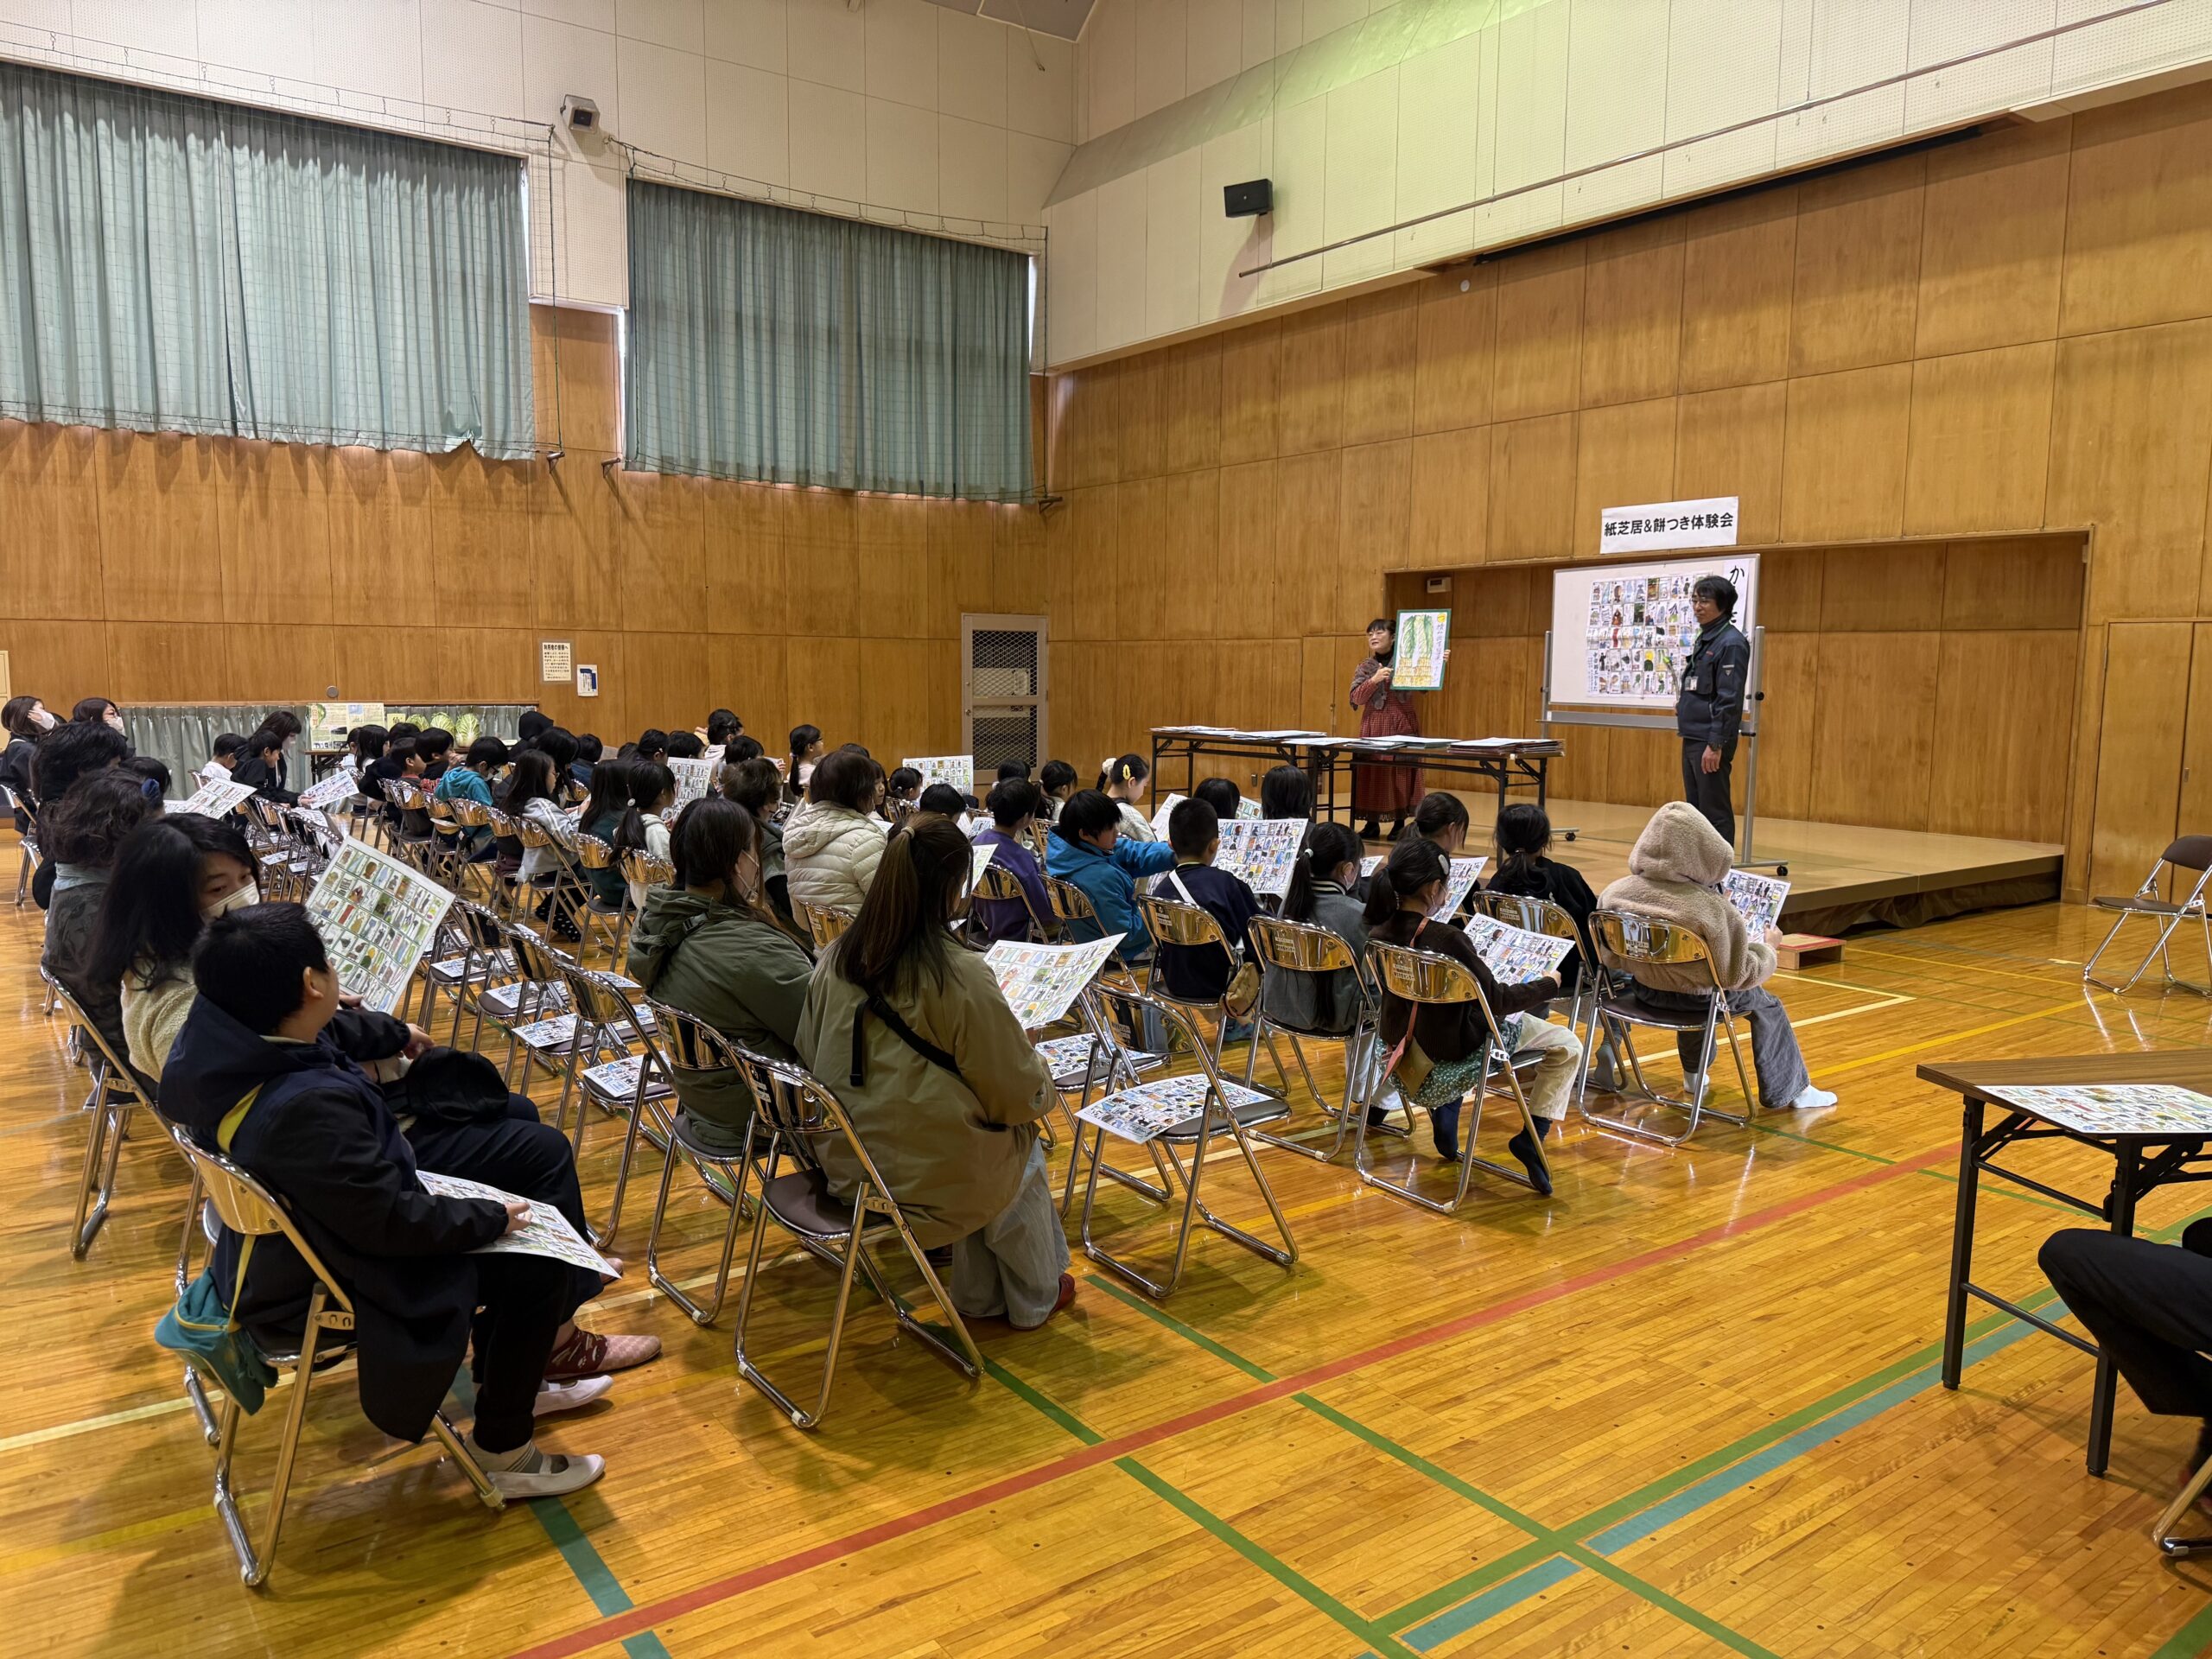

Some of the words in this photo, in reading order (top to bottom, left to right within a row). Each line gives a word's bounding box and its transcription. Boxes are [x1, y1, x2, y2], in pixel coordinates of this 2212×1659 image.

[1605, 512, 1733, 537] 紙芝居&餅つき体験会
